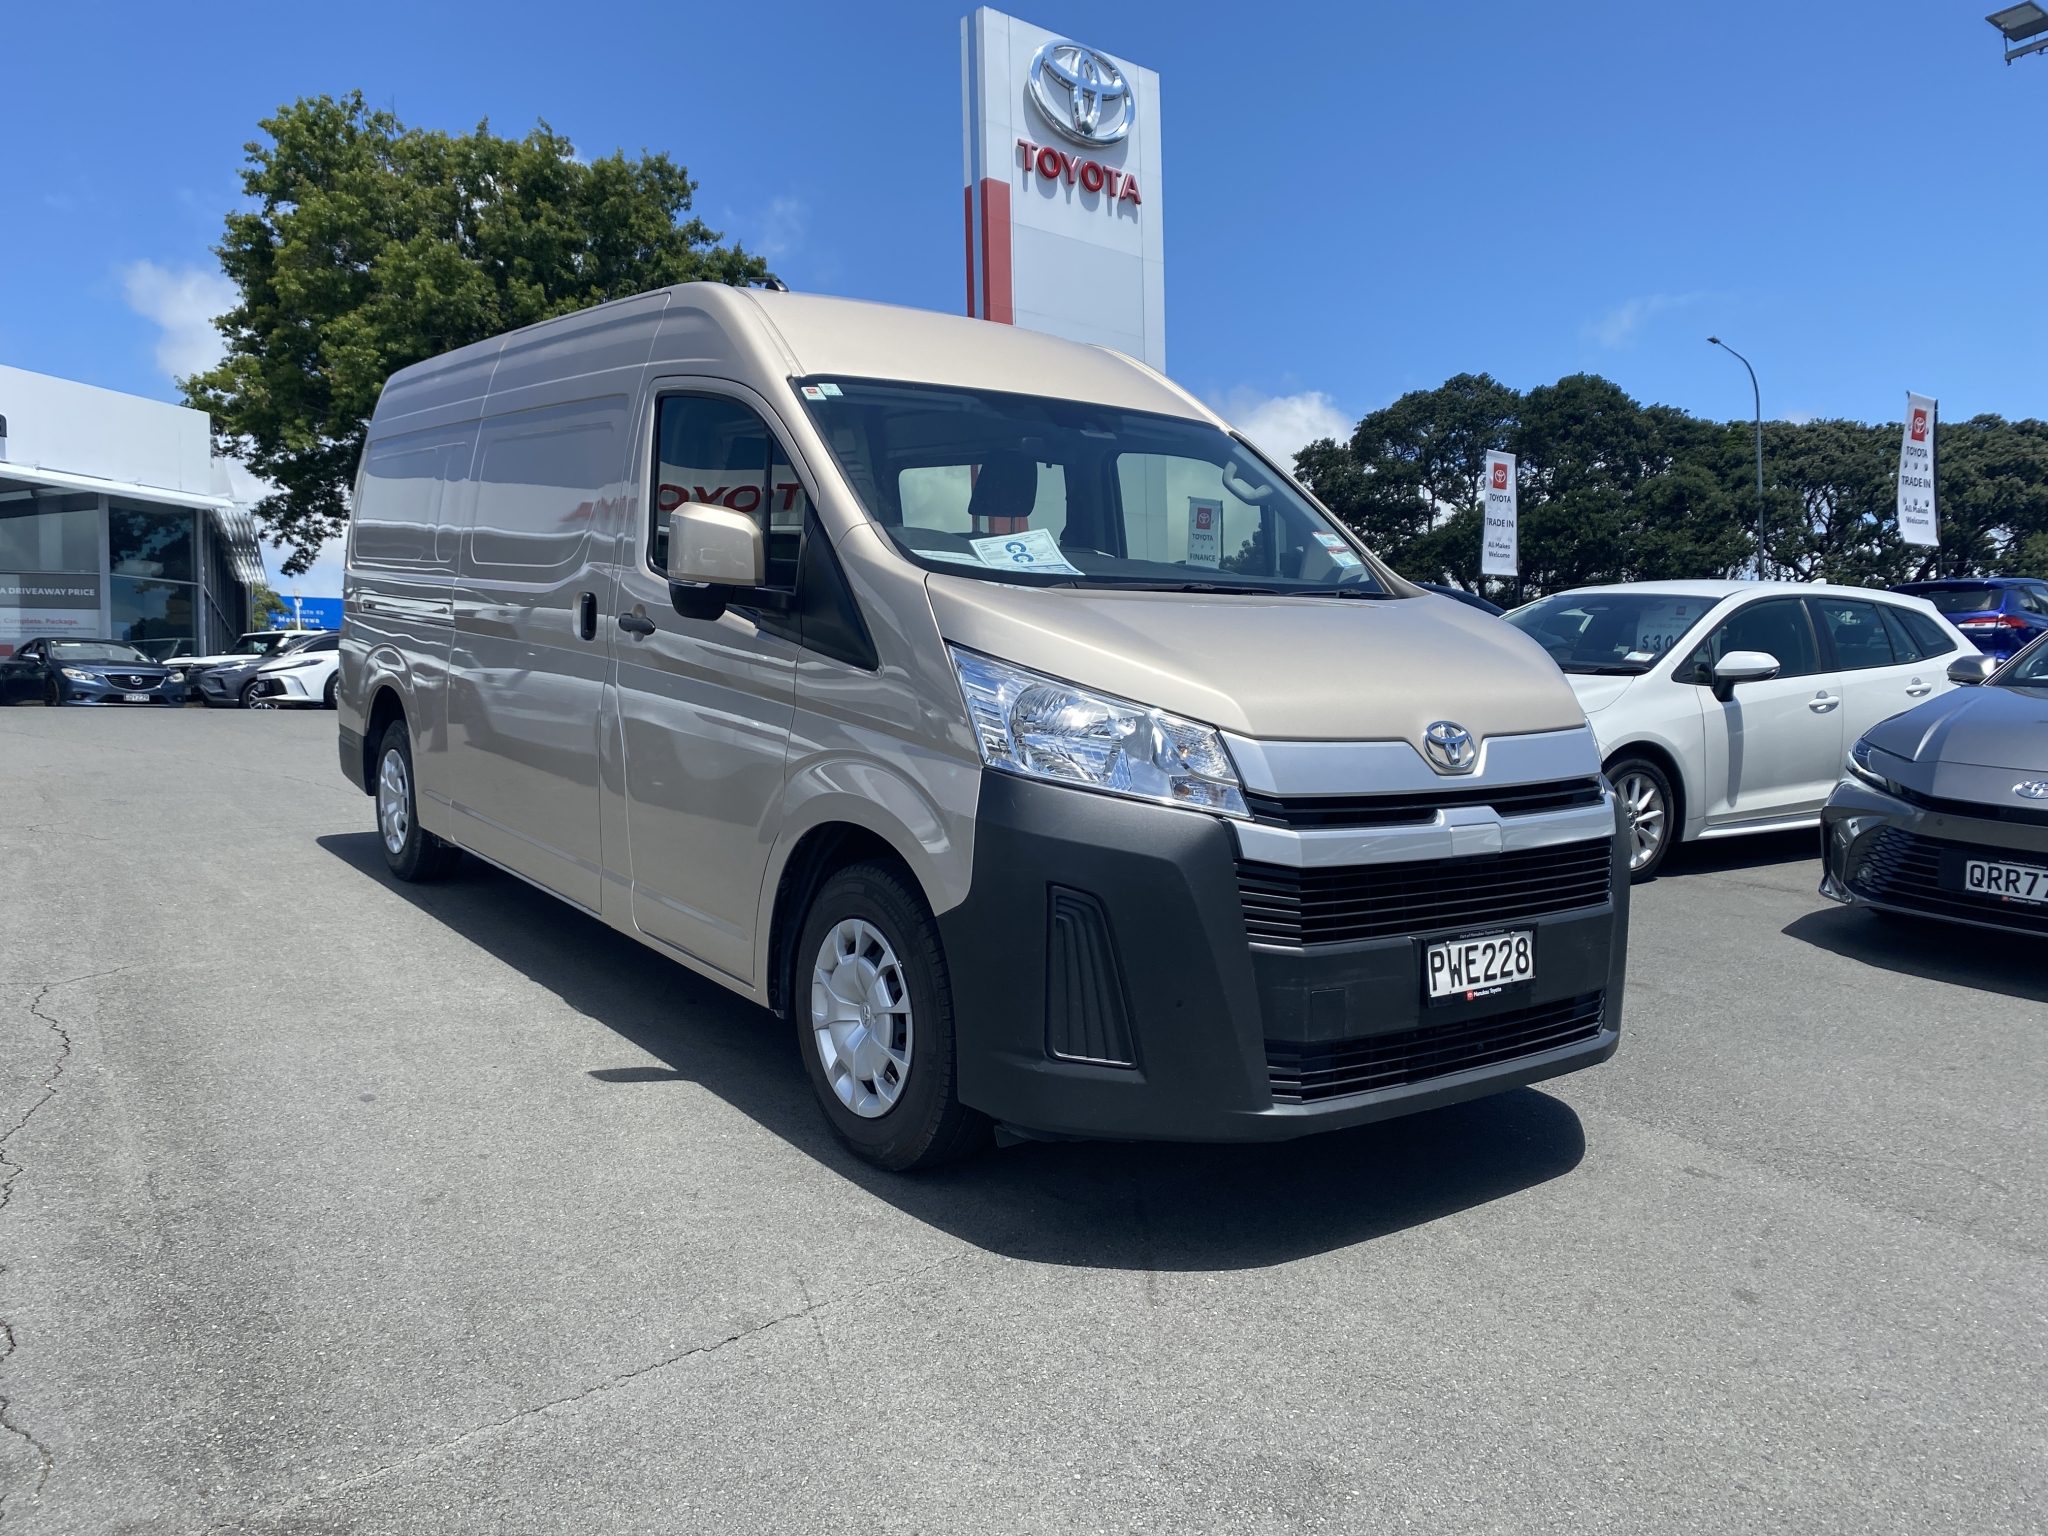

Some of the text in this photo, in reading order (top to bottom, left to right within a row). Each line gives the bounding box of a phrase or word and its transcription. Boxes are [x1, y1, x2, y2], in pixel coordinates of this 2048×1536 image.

[1016, 138, 1142, 205] TOYOTA
[1906, 446, 1928, 458] TOYOTA
[1902, 476, 1931, 488] TRADE IN
[1489, 493, 1511, 503] TOYOTA
[1486, 518, 1514, 528] TRADE IN
[1906, 516, 1928, 525] Welcome
[1192, 533, 1213, 541] TOYOTA
[1190, 552, 1216, 562] FINANCE
[8, 587, 66, 596] DRIVEAWAY
[68, 588, 95, 596] PRICE
[278, 616, 320, 624] Manrewa
[1430, 937, 1530, 991] PWE228
